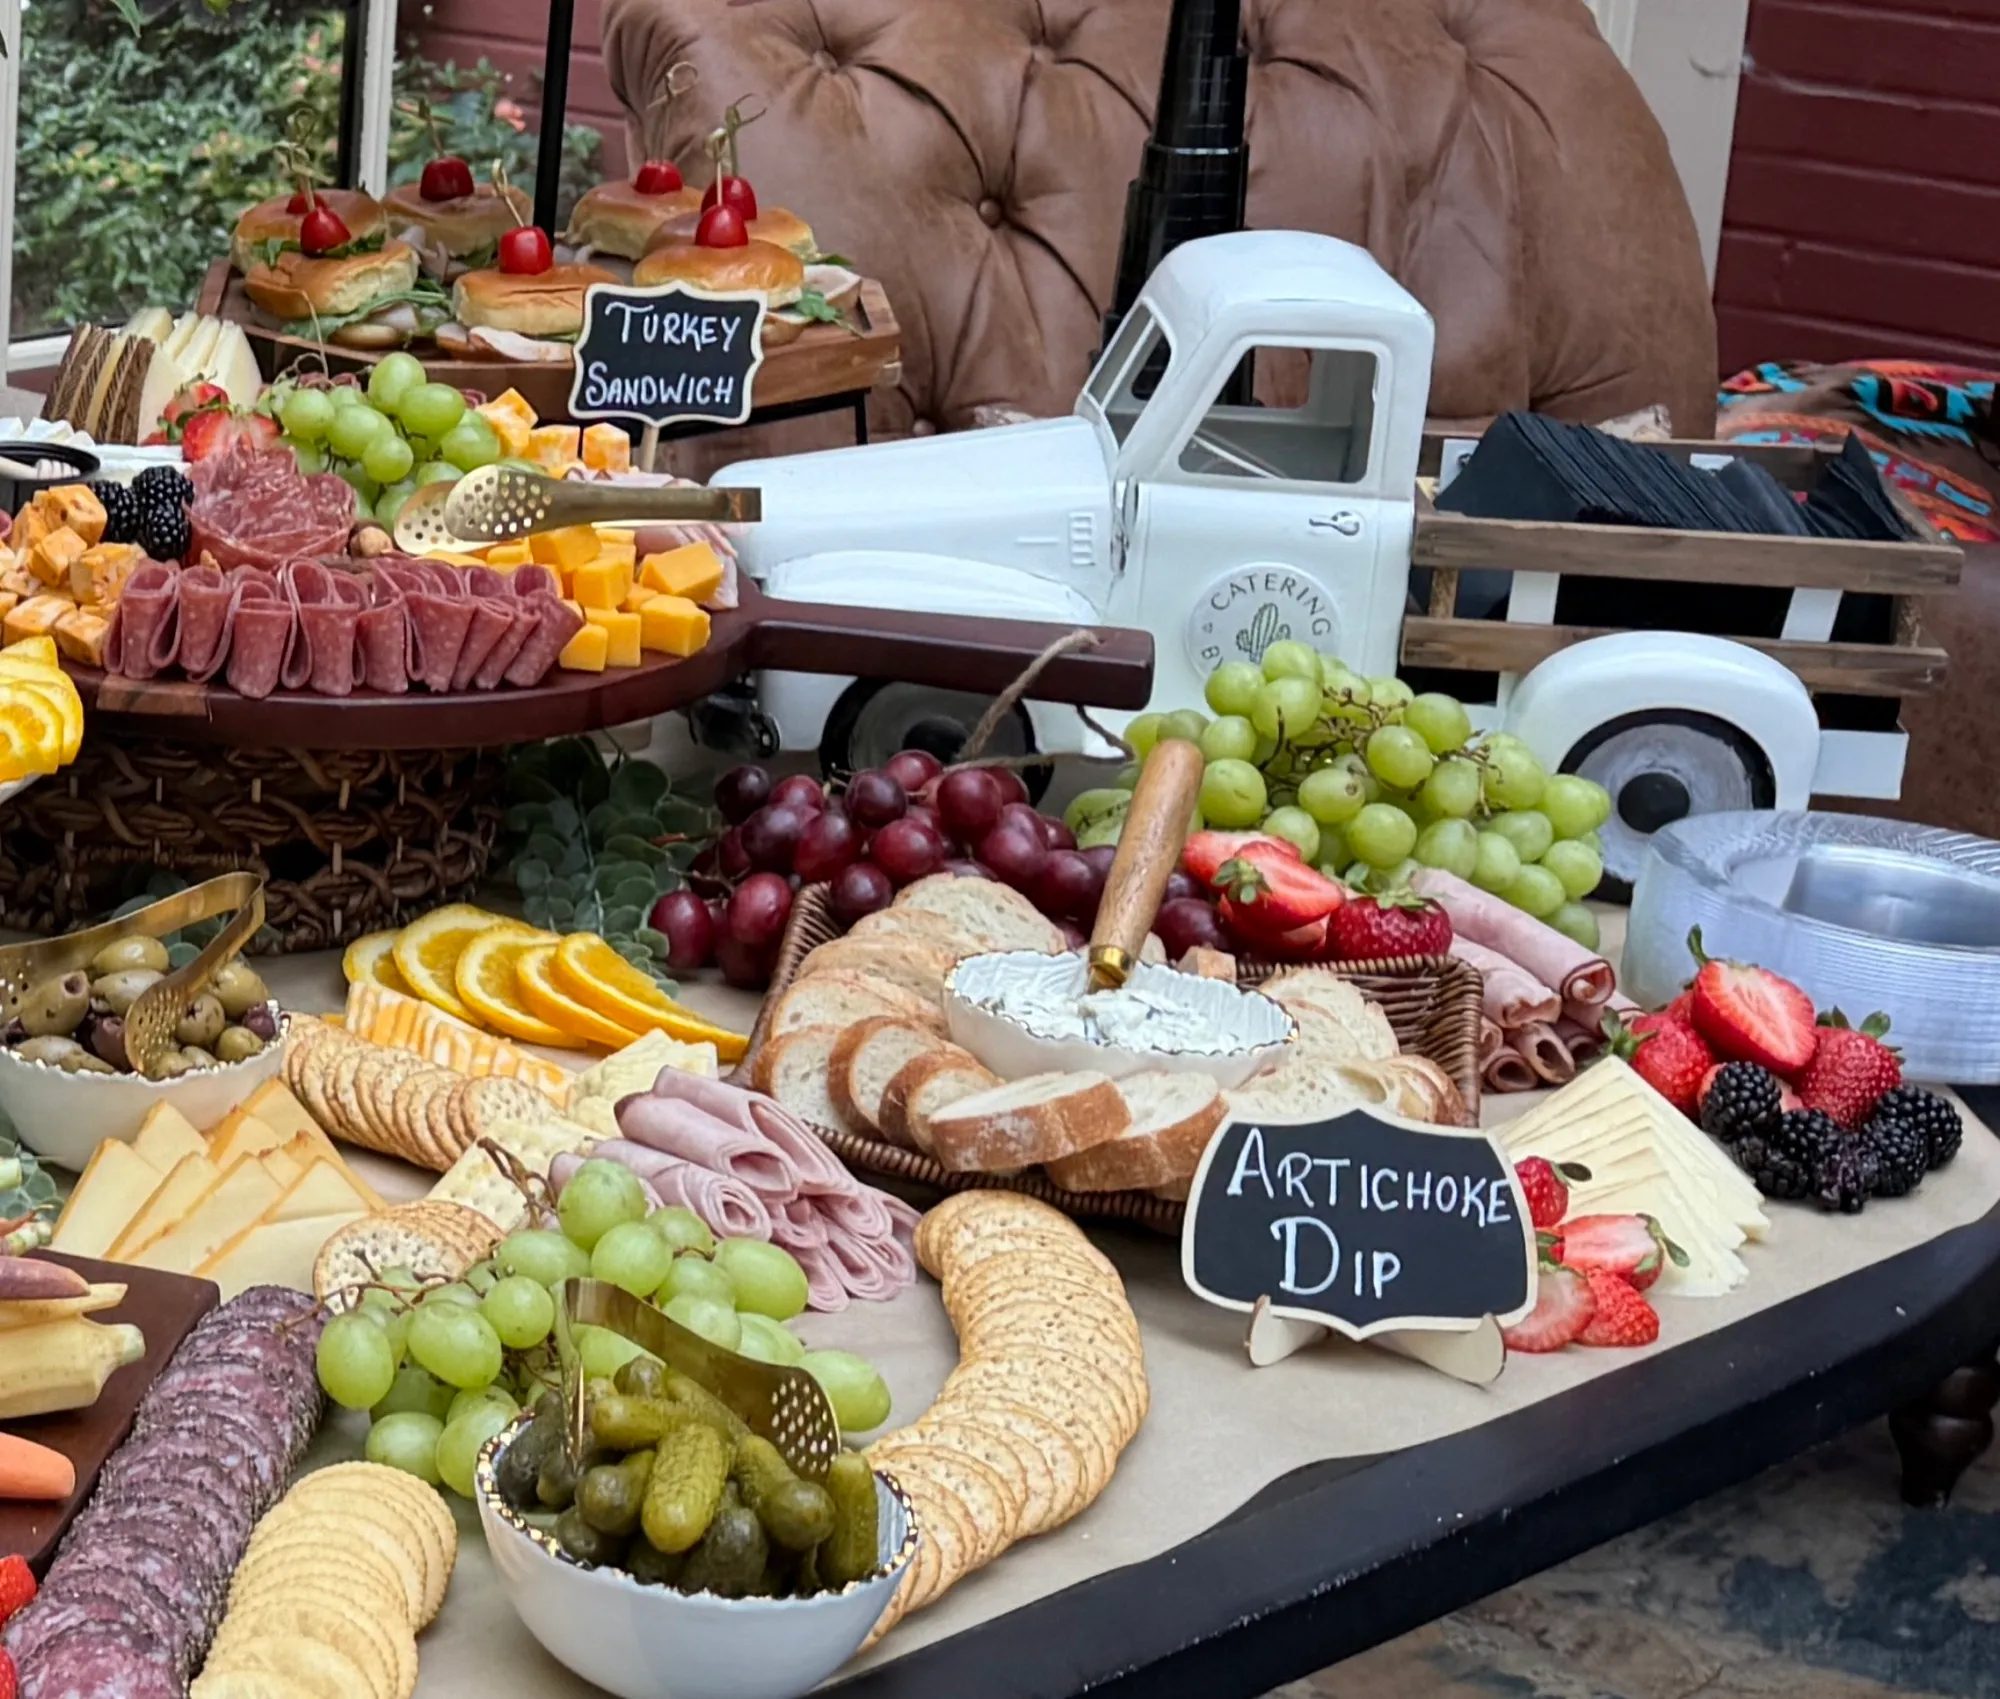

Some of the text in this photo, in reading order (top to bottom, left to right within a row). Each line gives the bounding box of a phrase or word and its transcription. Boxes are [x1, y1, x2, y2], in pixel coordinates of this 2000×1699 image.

[605, 302, 741, 352] TURKEY
[585, 361, 734, 407] SANDWICH
[1210, 573, 1331, 636] CATERING
[1226, 1127, 1511, 1228] ARTICHOKE
